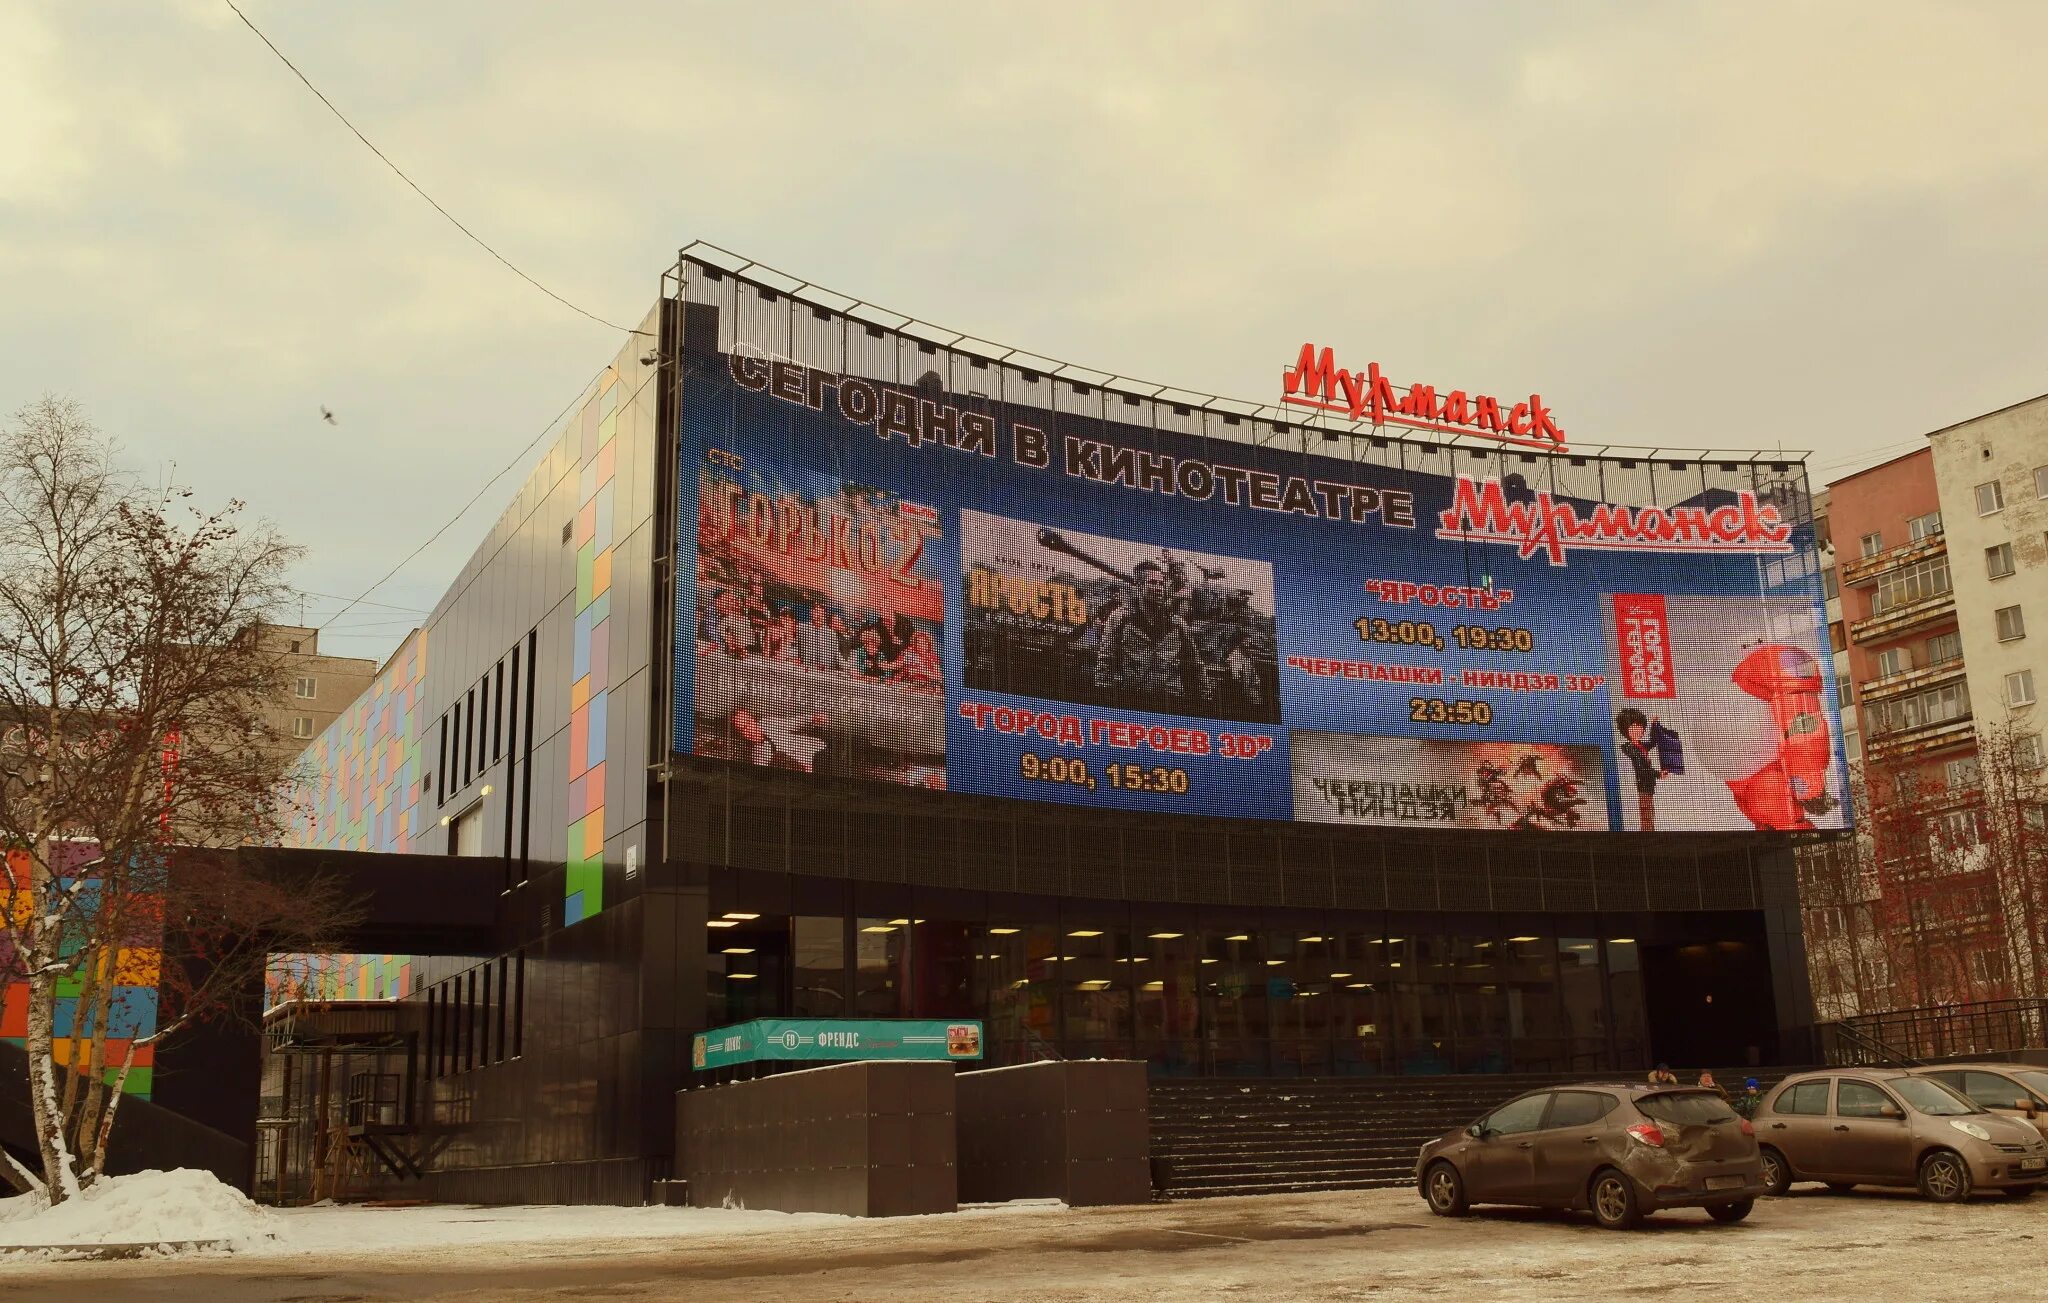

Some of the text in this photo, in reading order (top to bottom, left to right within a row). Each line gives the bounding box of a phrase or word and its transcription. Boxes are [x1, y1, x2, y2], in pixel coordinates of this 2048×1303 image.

[1283, 343, 1566, 443] Мурманск
[728, 342, 1416, 528] СЕГОДНЯ В КИНОТЕАТРЕ
[1441, 475, 1793, 566] Мурманск
[969, 566, 1088, 626] ЯРОСТЬ
[1354, 616, 1533, 653] 13:00, 19:30
[1463, 670, 1560, 692] НИНДЗЯ
[1408, 698, 1493, 725] 23:50
[1090, 718, 1212, 756] ГЕРОЕВ
[1019, 752, 1190, 794] 9:00, 15:30
[1312, 777, 1468, 808] ЧЕРЕПАШКИ
[1337, 797, 1457, 821] НИНДЗЯ
[818, 1032, 860, 1049] ФРЕНДС
